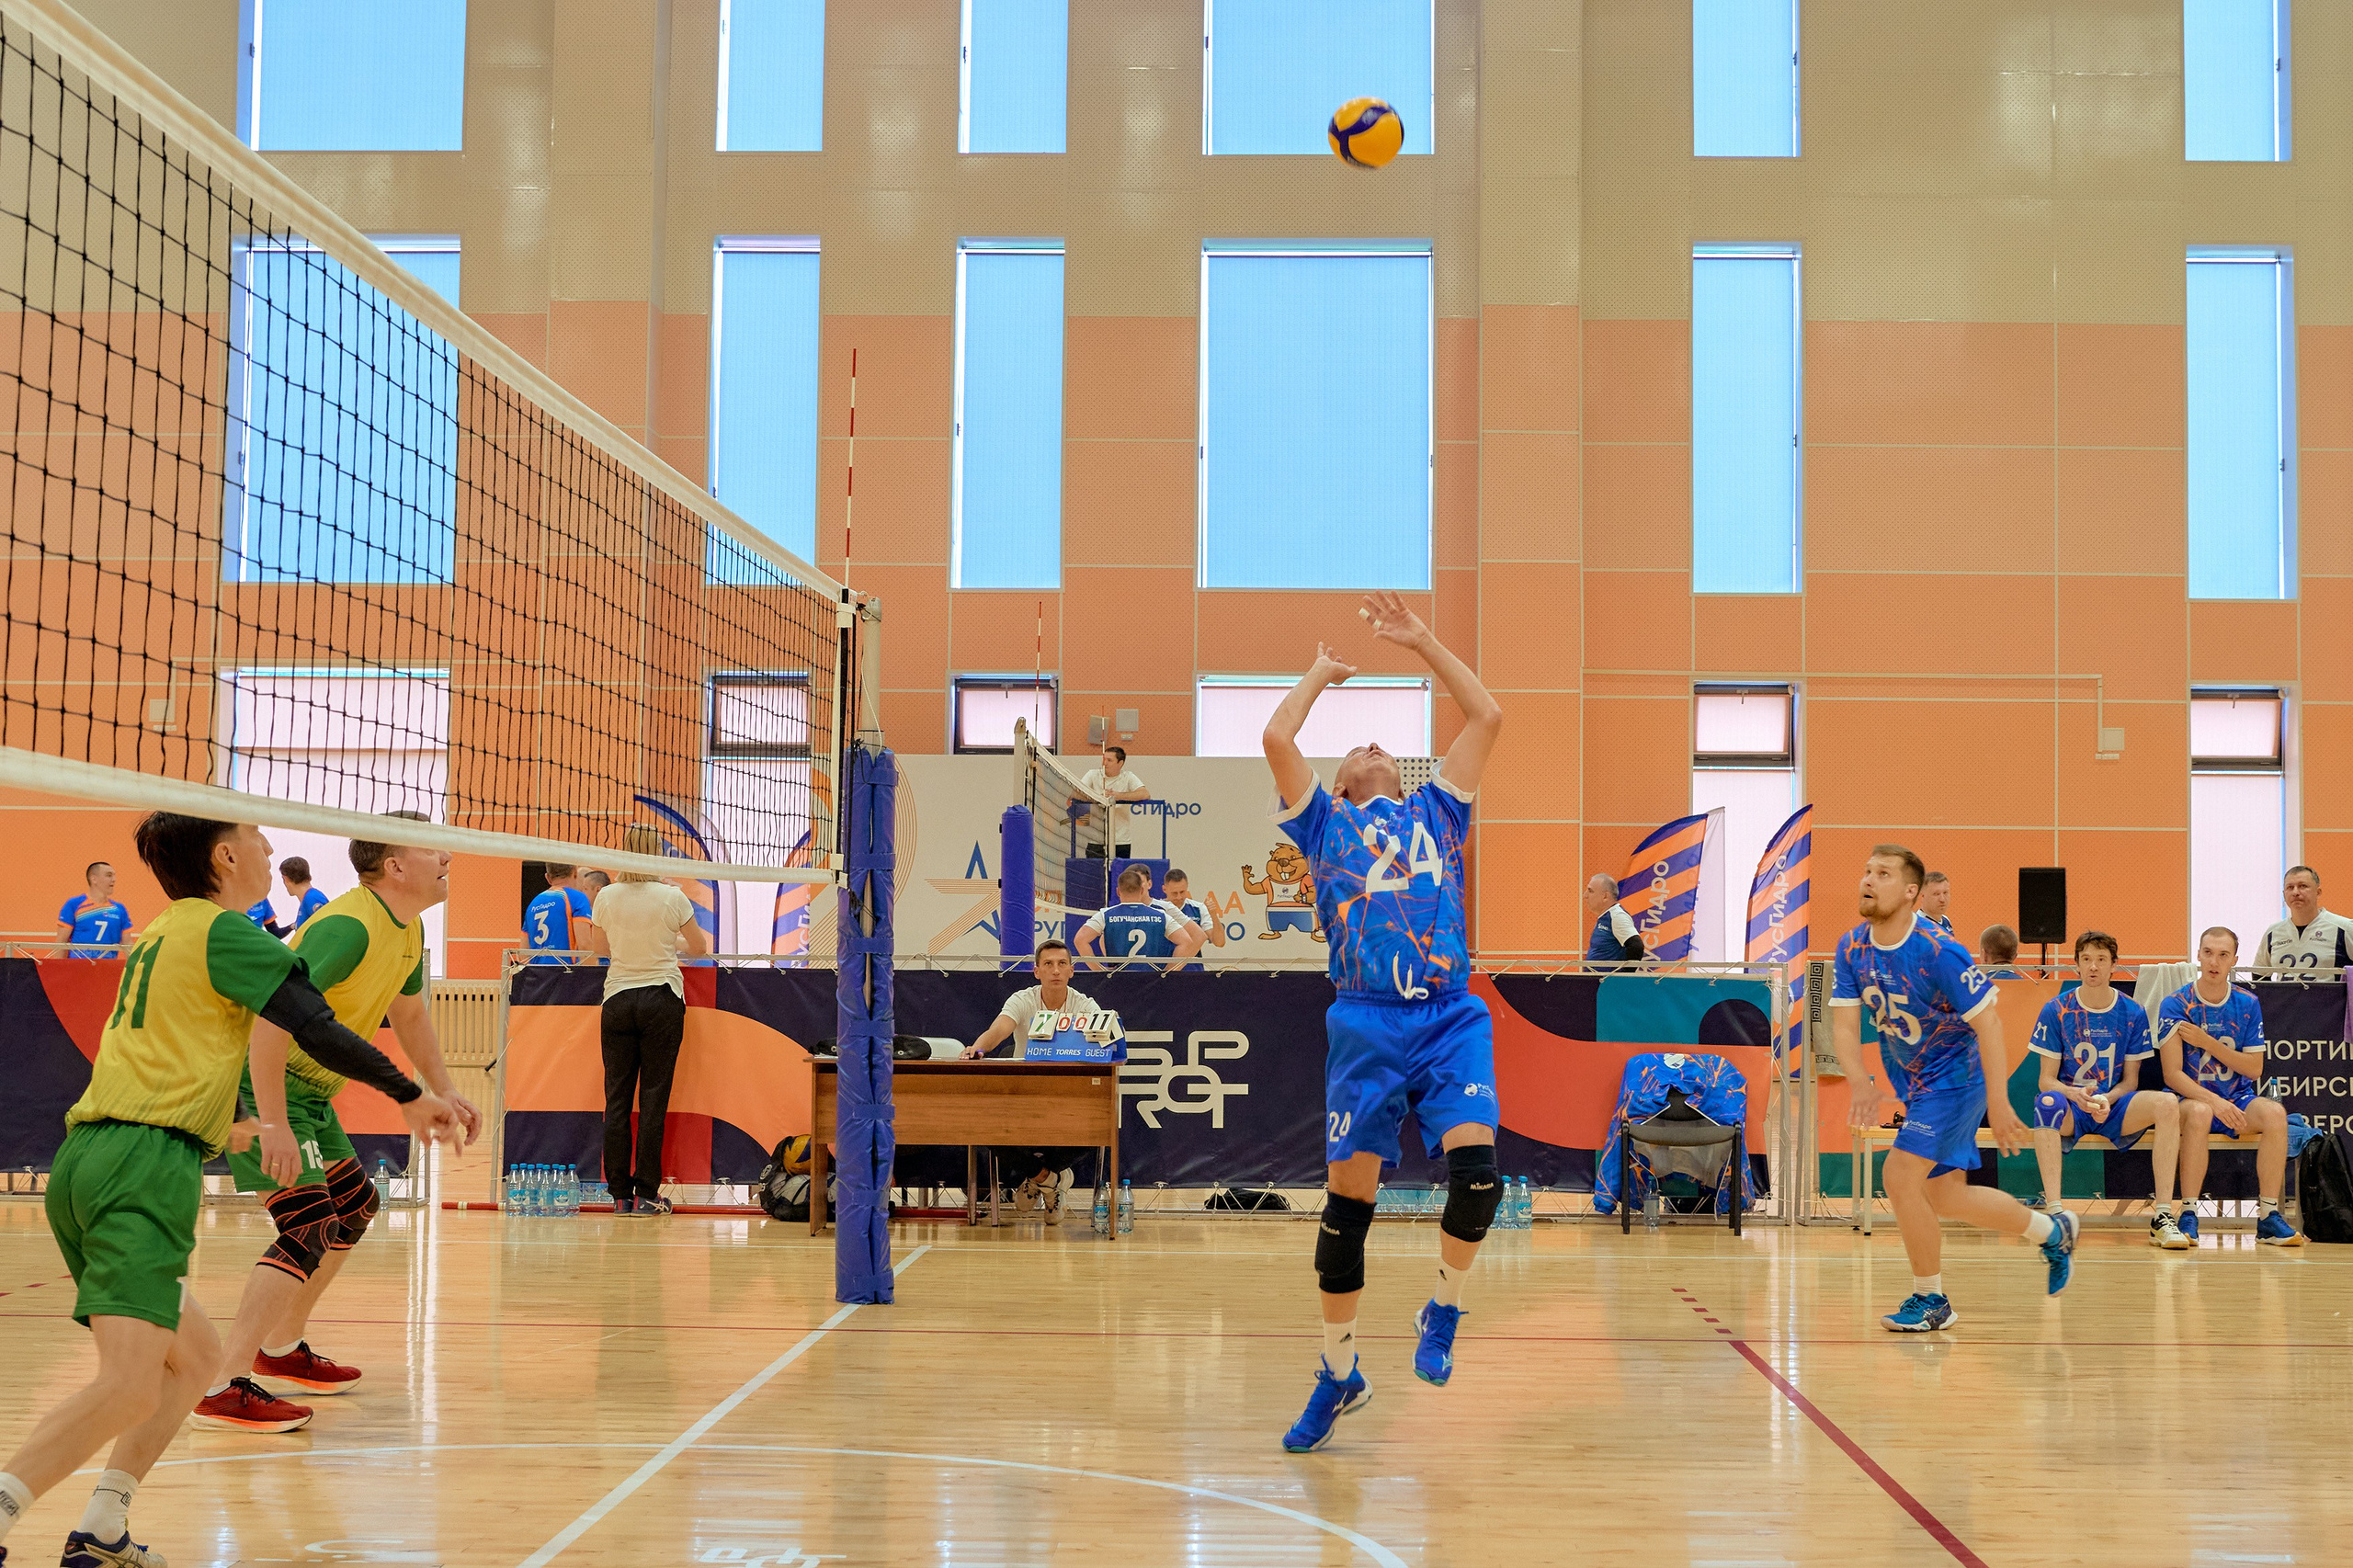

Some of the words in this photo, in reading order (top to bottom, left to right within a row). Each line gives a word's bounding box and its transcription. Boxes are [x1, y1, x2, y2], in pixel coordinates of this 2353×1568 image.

[1363, 821, 1443, 893] 24
[95, 921, 108, 941] 7
[534, 910, 550, 945] 3
[1640, 860, 1671, 972] усГидро
[1128, 929, 1147, 958] 2
[1959, 965, 1988, 995] 25
[2279, 952, 2318, 982] 22
[108, 935, 165, 1030] 11
[1035, 1014, 1053, 1033] 7
[1088, 1013, 1110, 1030] 11
[1862, 985, 1923, 1046] 25
[2032, 1021, 2048, 1041] 21
[1027, 1048, 1052, 1057] HOME
[1085, 1049, 1111, 1057] GUEST
[2072, 1041, 2117, 1088] 21
[2256, 1075, 2353, 1097] ИБИРС
[1328, 1110, 1352, 1142] 24
[300, 1140, 324, 1170] 15
